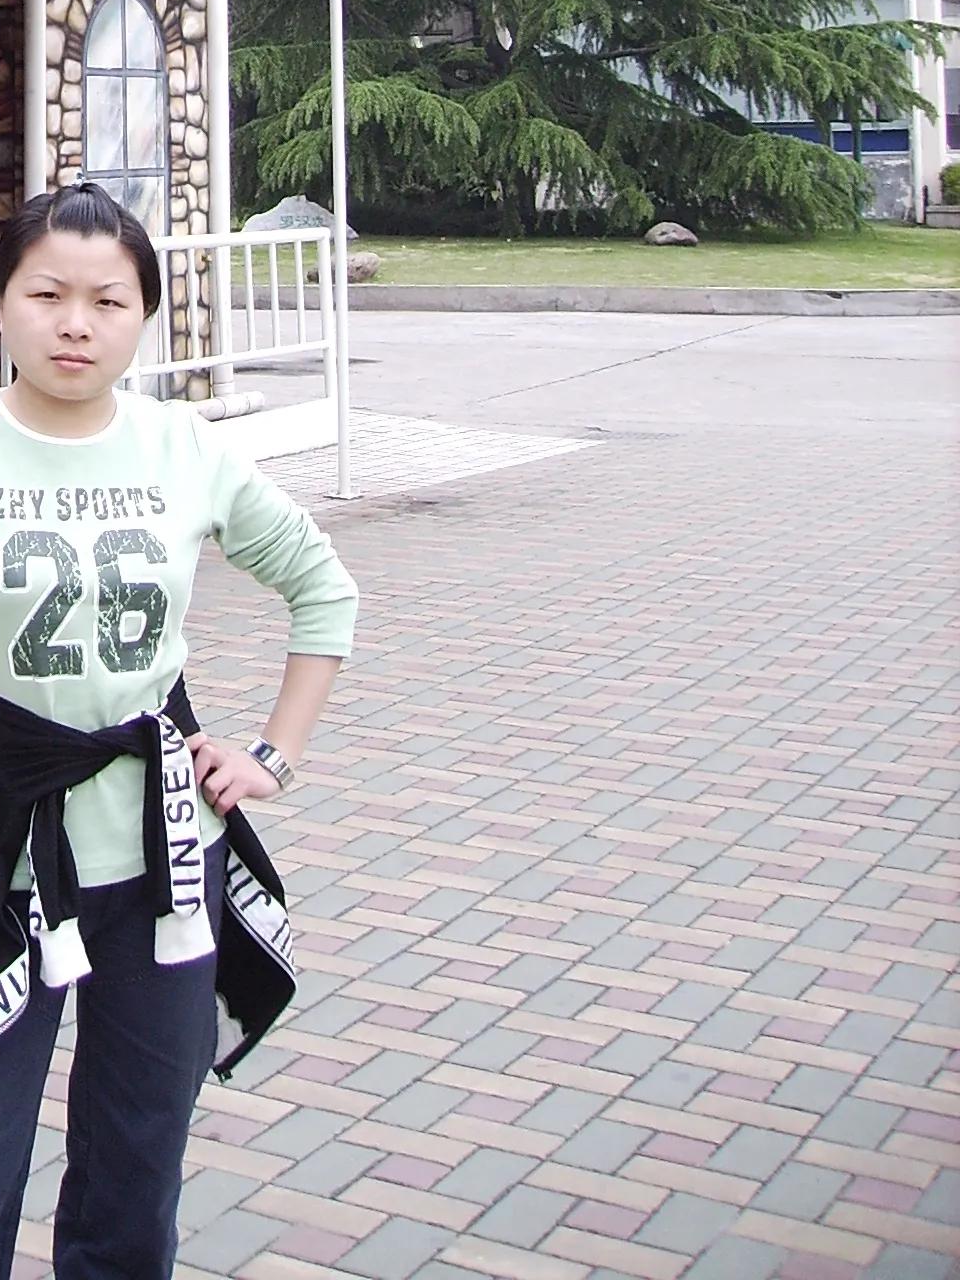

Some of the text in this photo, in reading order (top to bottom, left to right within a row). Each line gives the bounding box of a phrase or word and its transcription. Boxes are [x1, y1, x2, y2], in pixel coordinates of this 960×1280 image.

[56, 485, 166, 521] SPORTS
[2, 528, 169, 677] 26
[164, 766, 202, 918] JINSE
